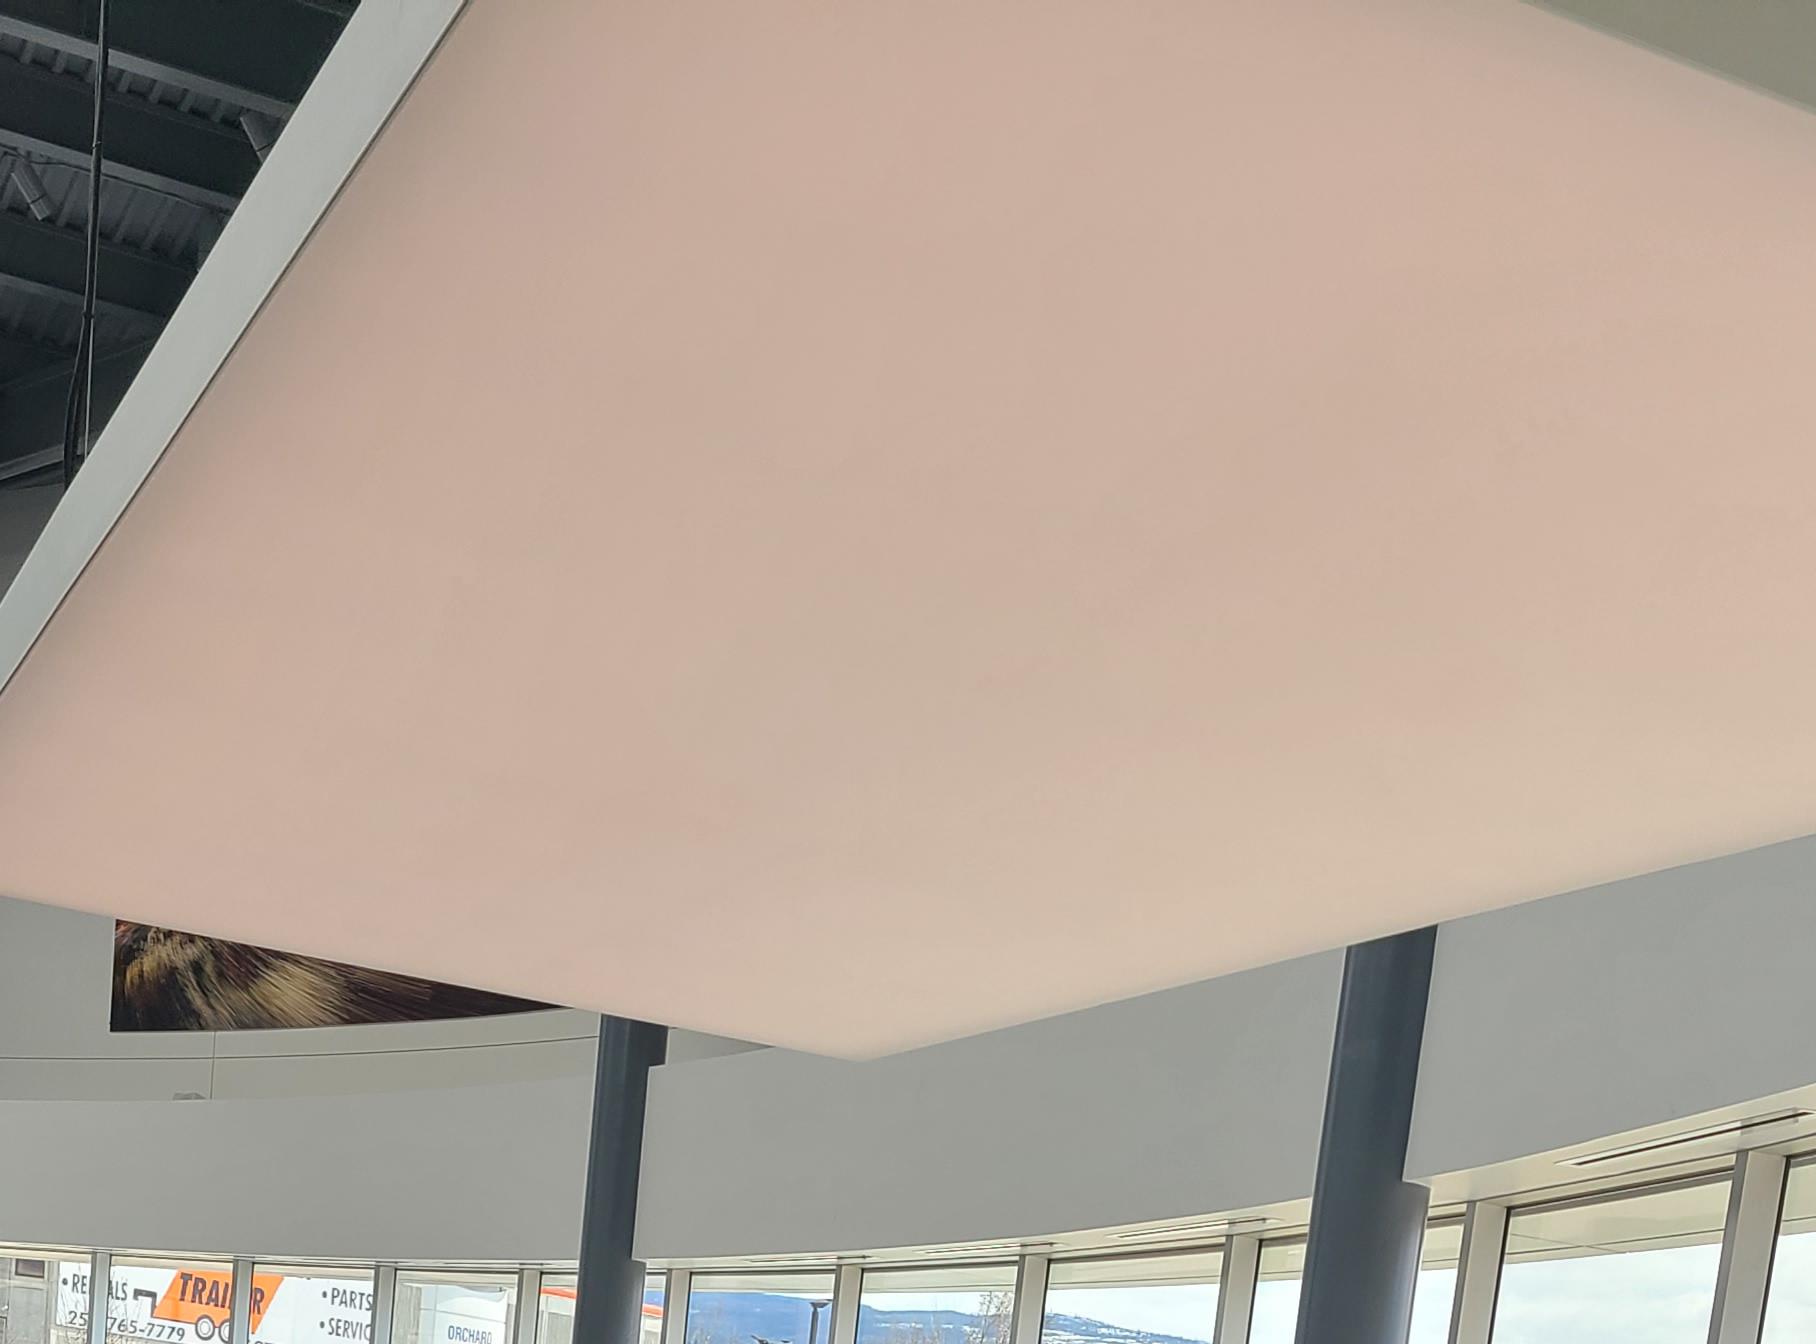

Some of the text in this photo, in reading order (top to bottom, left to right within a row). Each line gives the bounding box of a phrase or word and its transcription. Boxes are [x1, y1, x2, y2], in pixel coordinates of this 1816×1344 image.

[71, 1273, 128, 1301] REALS
[180, 1272, 265, 1316] TRAIR
[331, 1287, 374, 1312] PARTS
[328, 1317, 372, 1342] SERVIC
